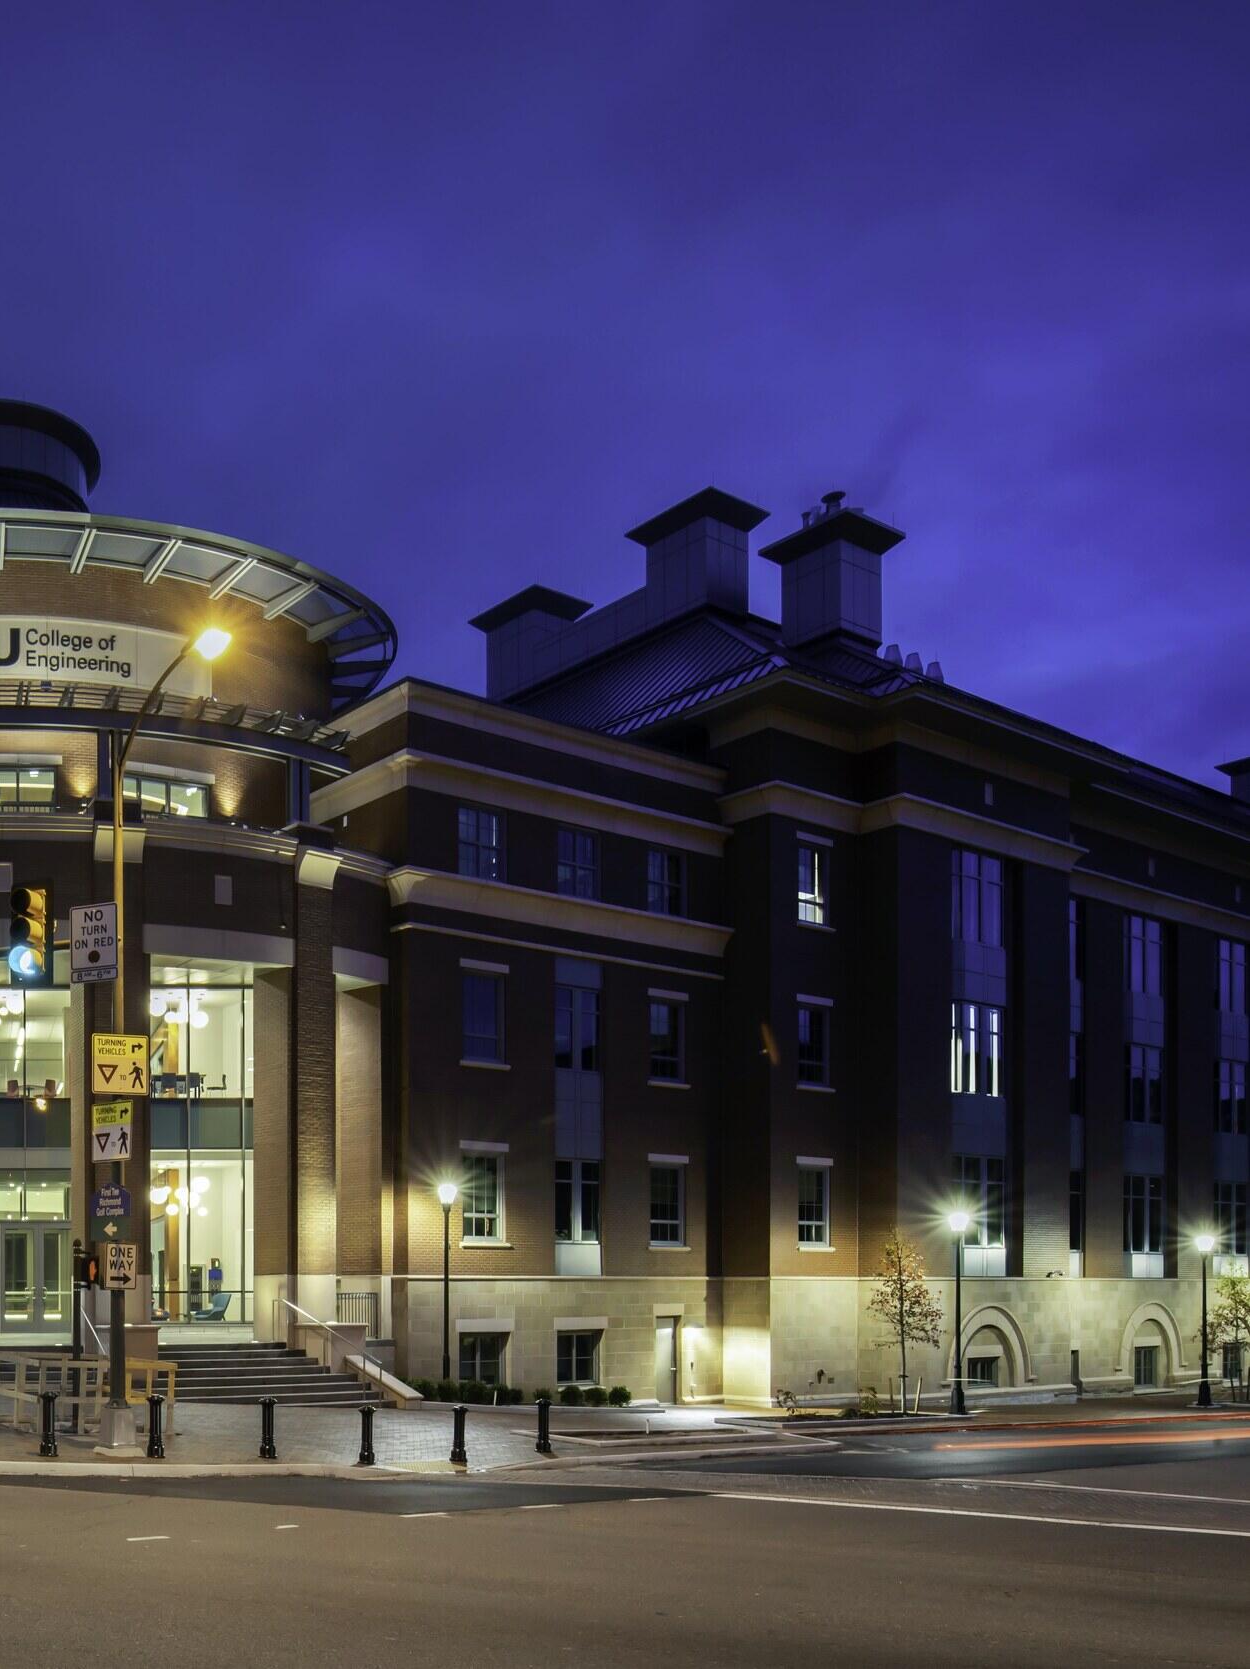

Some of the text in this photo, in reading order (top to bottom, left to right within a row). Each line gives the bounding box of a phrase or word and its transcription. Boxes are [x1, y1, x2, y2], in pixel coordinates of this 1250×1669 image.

[25, 628, 116, 652] College of
[26, 650, 131, 678] Engineering
[84, 909, 104, 923] NO
[81, 924, 108, 936] TURN
[74, 936, 114, 950] ON RED
[97, 1038, 127, 1047] TURNING
[97, 1047, 126, 1056] VEHICLES
[95, 1105, 118, 1115] TURNING
[95, 1114, 117, 1124] VEHICLES
[99, 1197, 122, 1207] Richmond
[95, 1206, 124, 1217] Golf Complex
[110, 1246, 134, 1259] ONE
[110, 1259, 134, 1271] WAY
